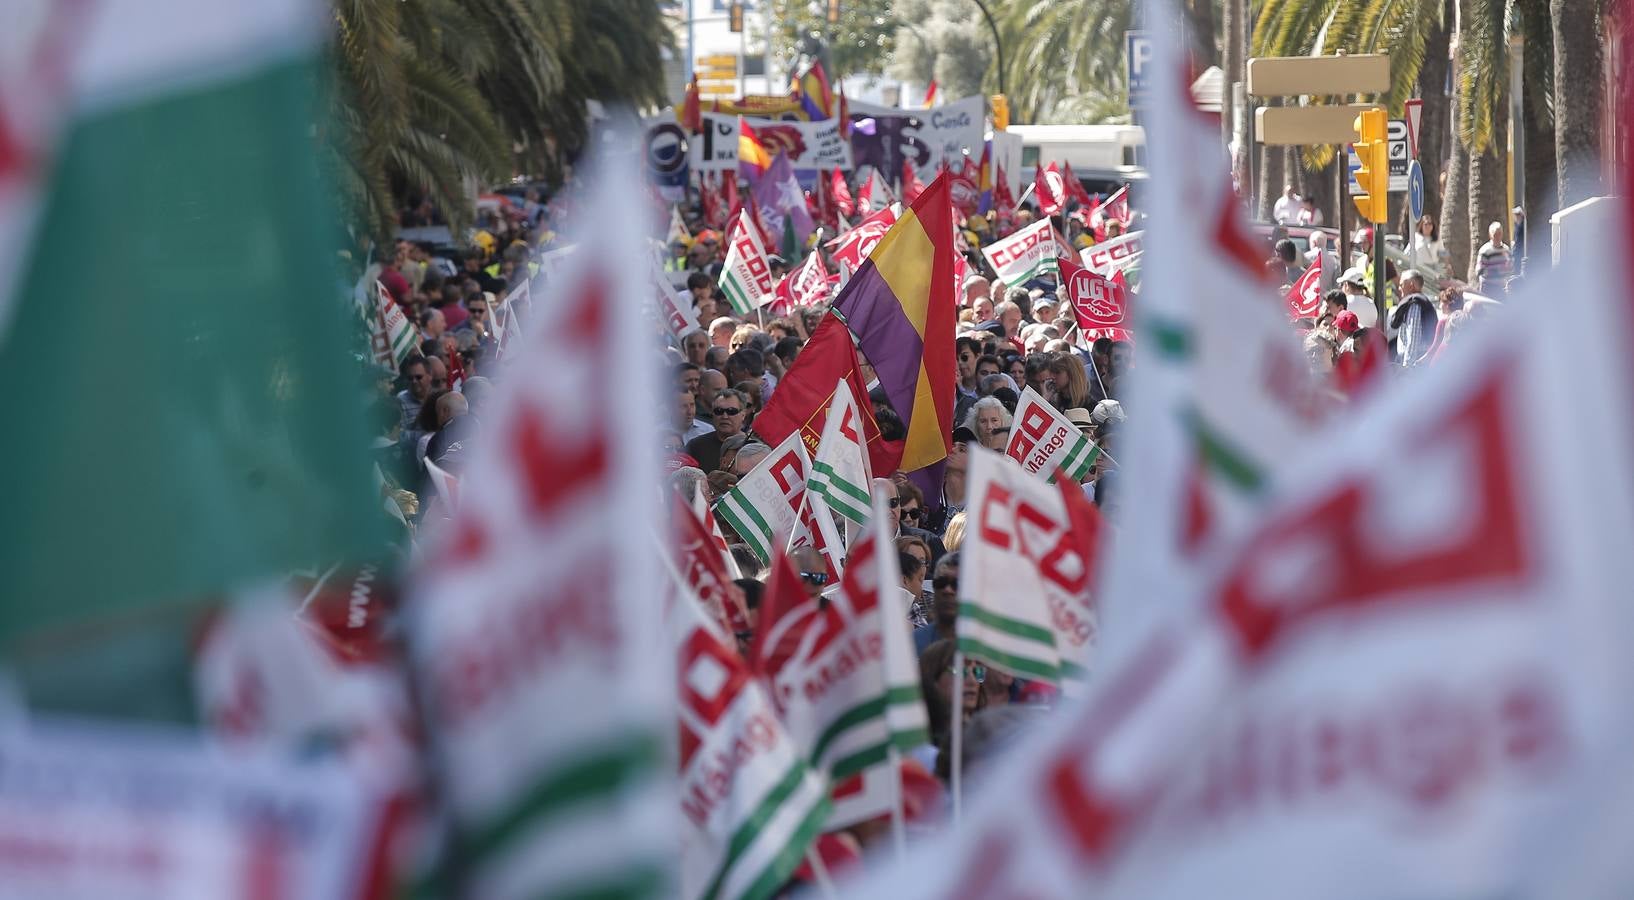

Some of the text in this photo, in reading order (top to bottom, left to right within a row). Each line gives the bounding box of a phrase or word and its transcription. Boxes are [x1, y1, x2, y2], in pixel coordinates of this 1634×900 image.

[1077, 276, 1117, 304] UGT
[803, 434, 820, 450] AN
[1024, 426, 1068, 474] Málaga
